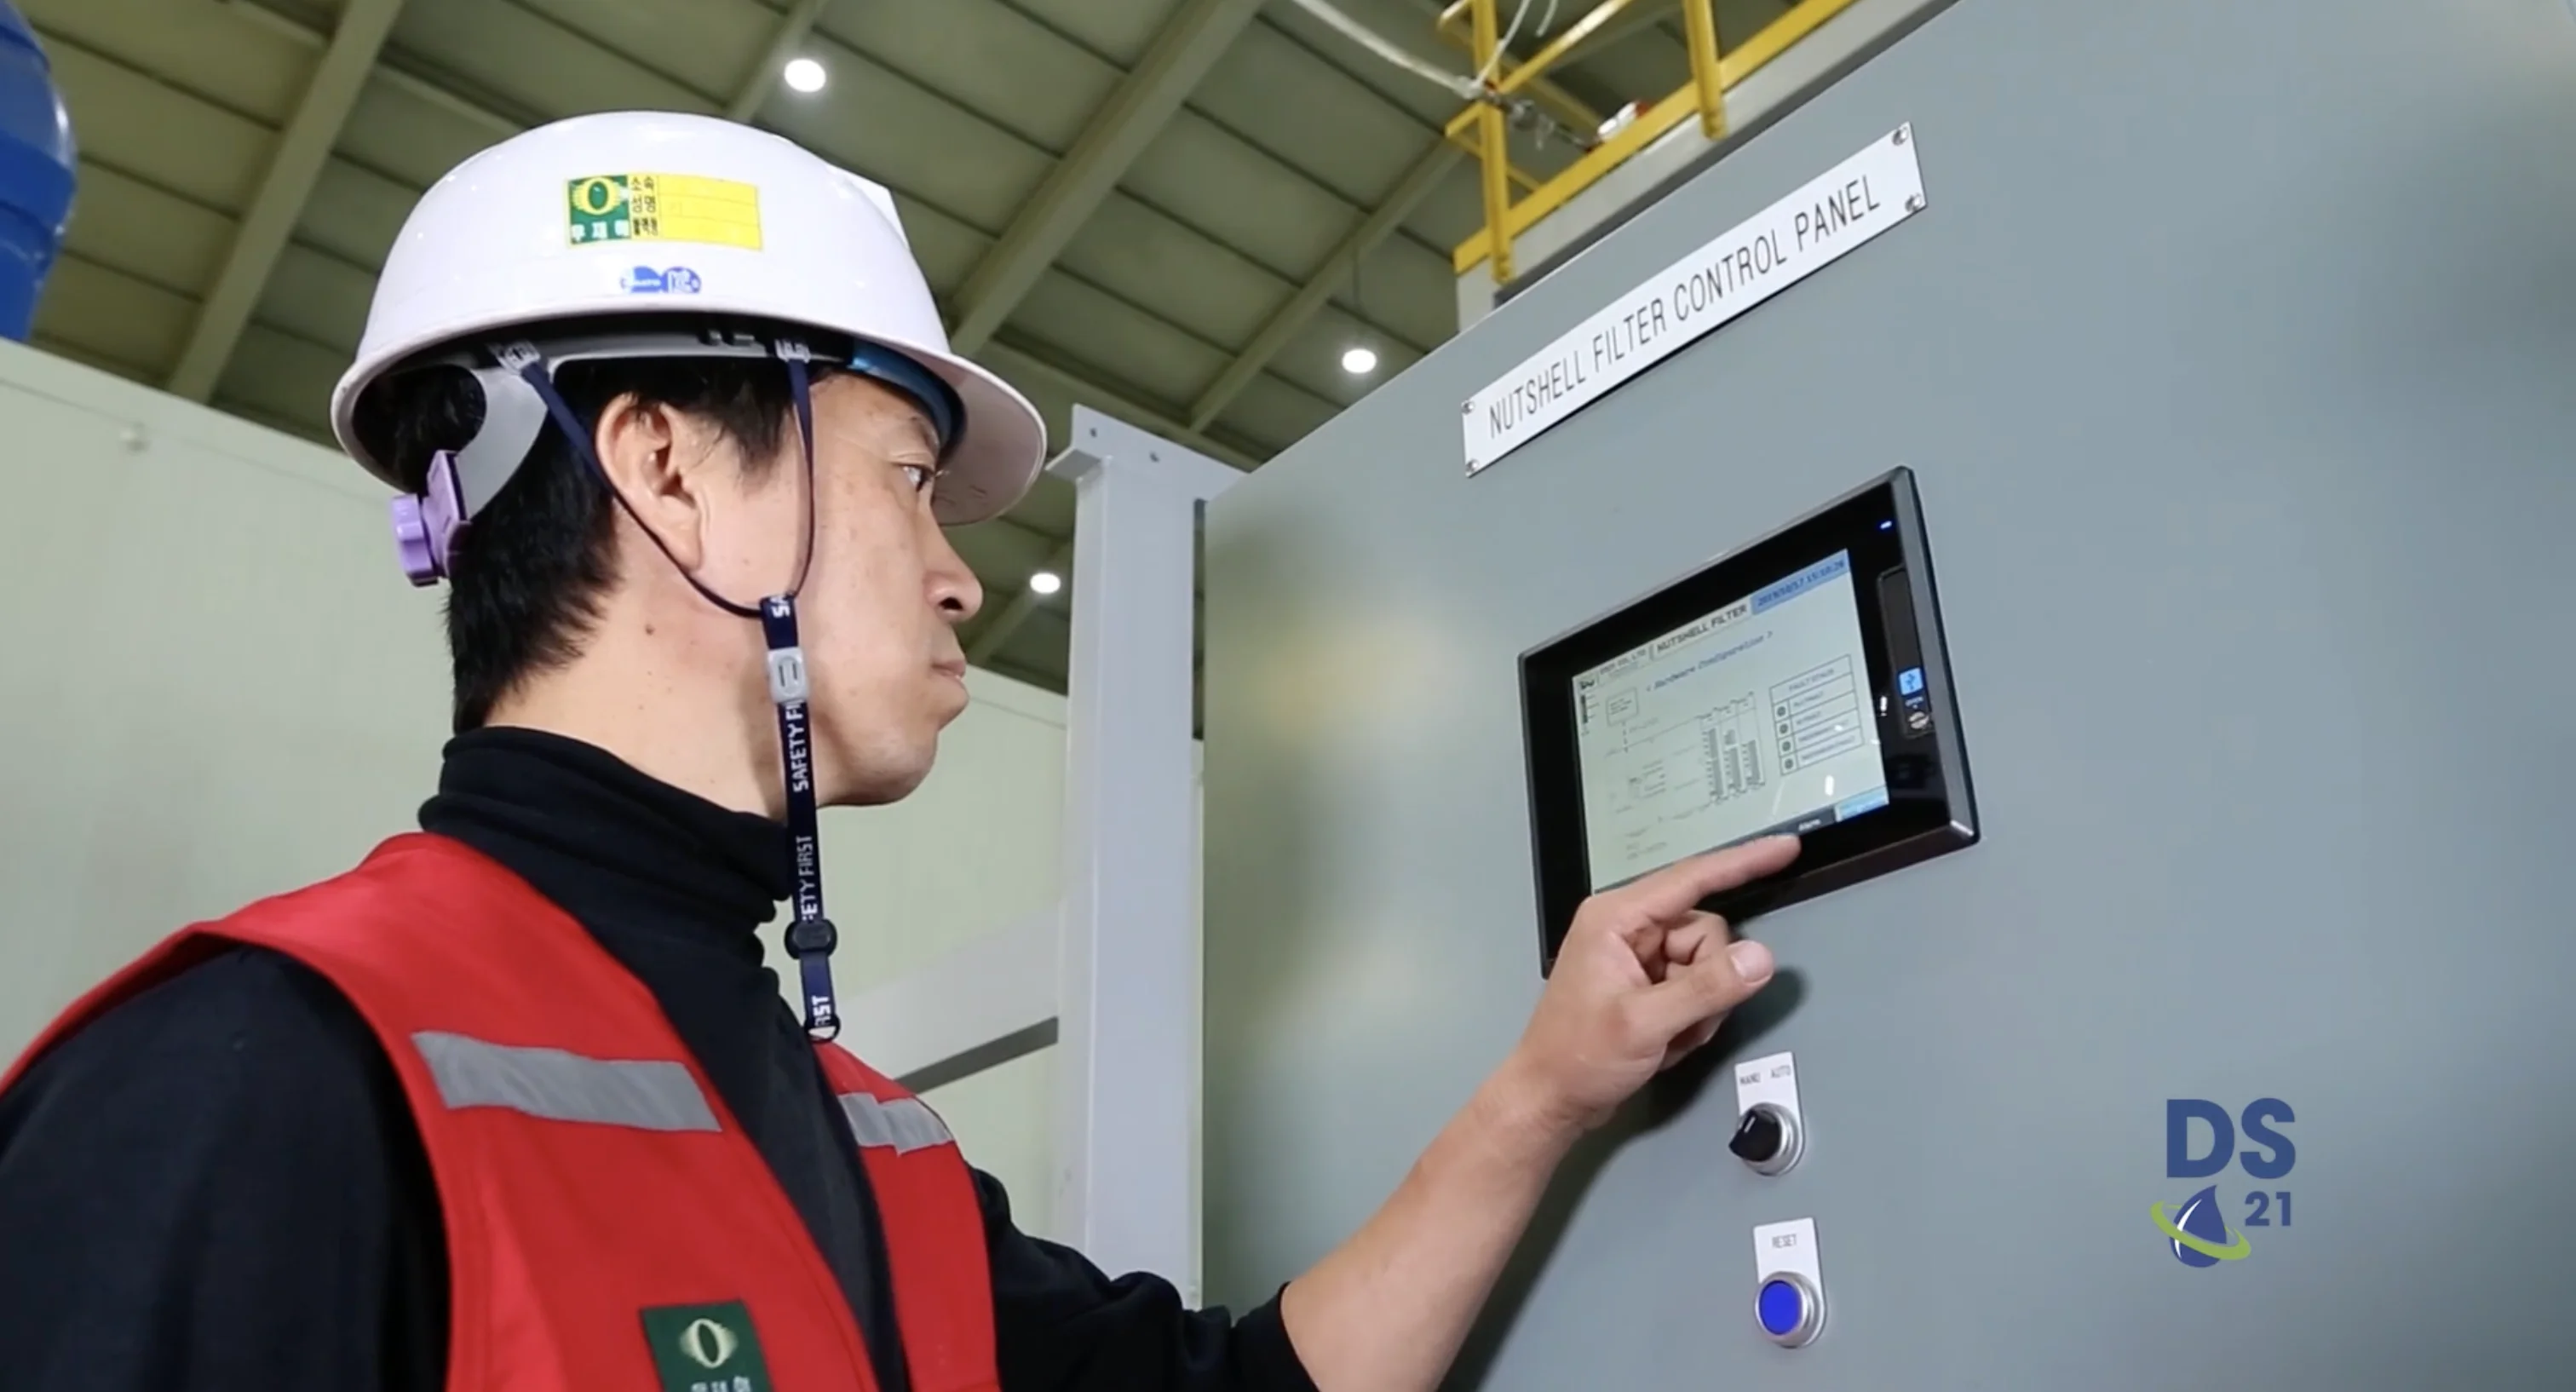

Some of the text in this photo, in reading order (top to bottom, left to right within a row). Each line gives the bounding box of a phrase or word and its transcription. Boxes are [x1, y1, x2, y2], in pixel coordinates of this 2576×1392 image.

[1489, 174, 1881, 439] NUTSHELL FILTER CONTROL PANEL
[1657, 603, 1747, 654] NUTSHELL FILTER
[787, 724, 809, 793] SAFETY
[796, 835, 815, 877] FIRST
[1771, 1234, 1797, 1247] RESET
